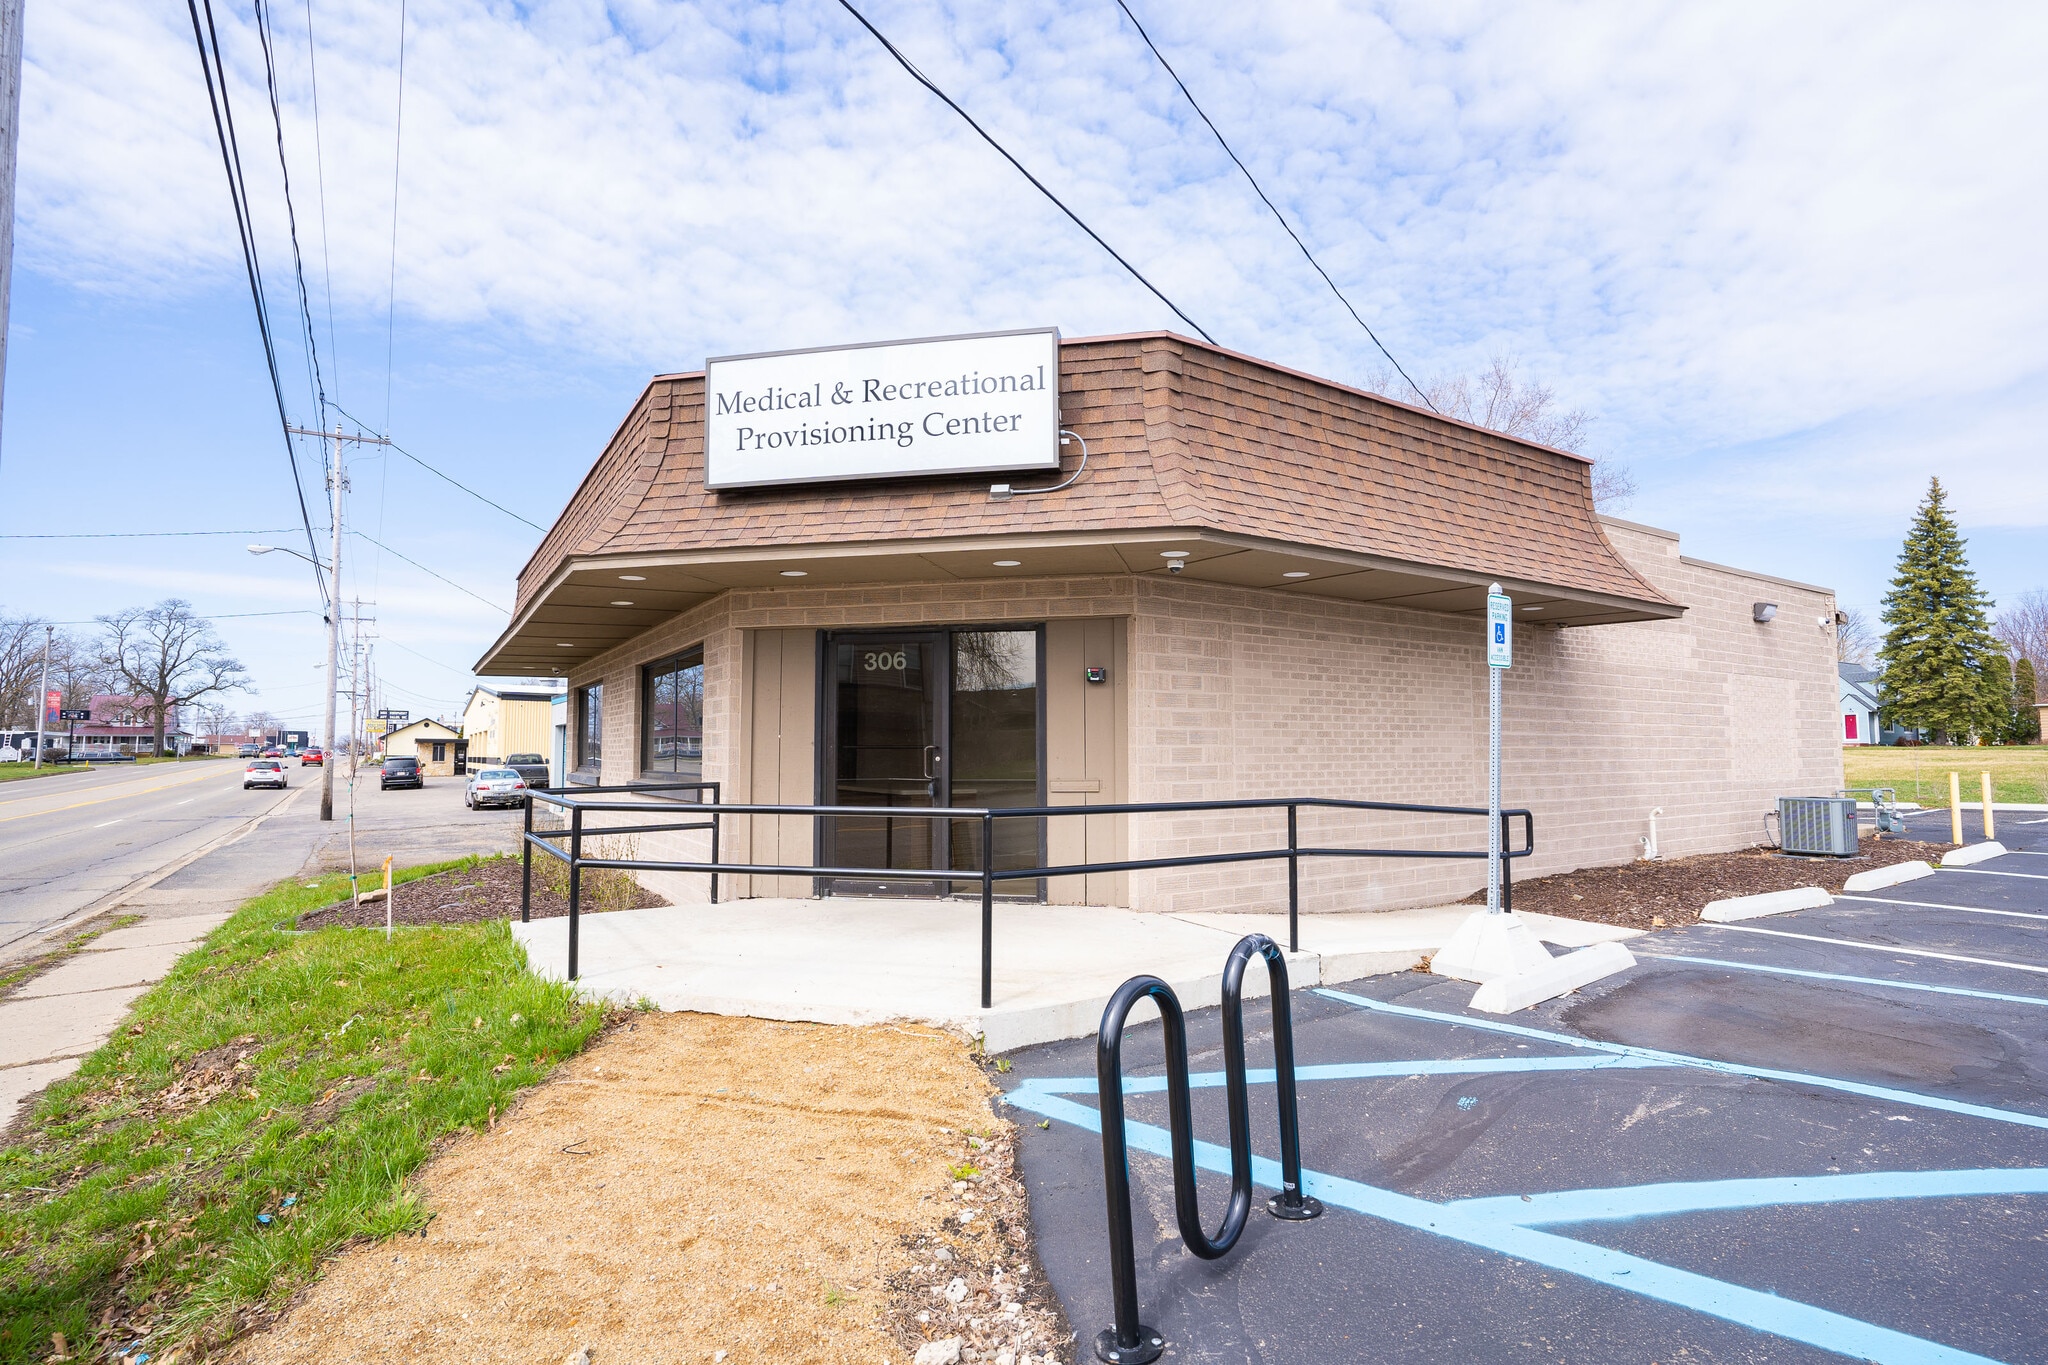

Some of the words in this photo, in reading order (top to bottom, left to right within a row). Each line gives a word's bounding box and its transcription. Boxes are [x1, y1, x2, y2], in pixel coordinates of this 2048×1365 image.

[716, 383, 822, 416] Medical
[831, 381, 854, 405] &
[862, 366, 1046, 403] Recreational
[736, 418, 914, 451] Provisioning
[923, 411, 1022, 436] Center
[864, 651, 907, 671] 306
